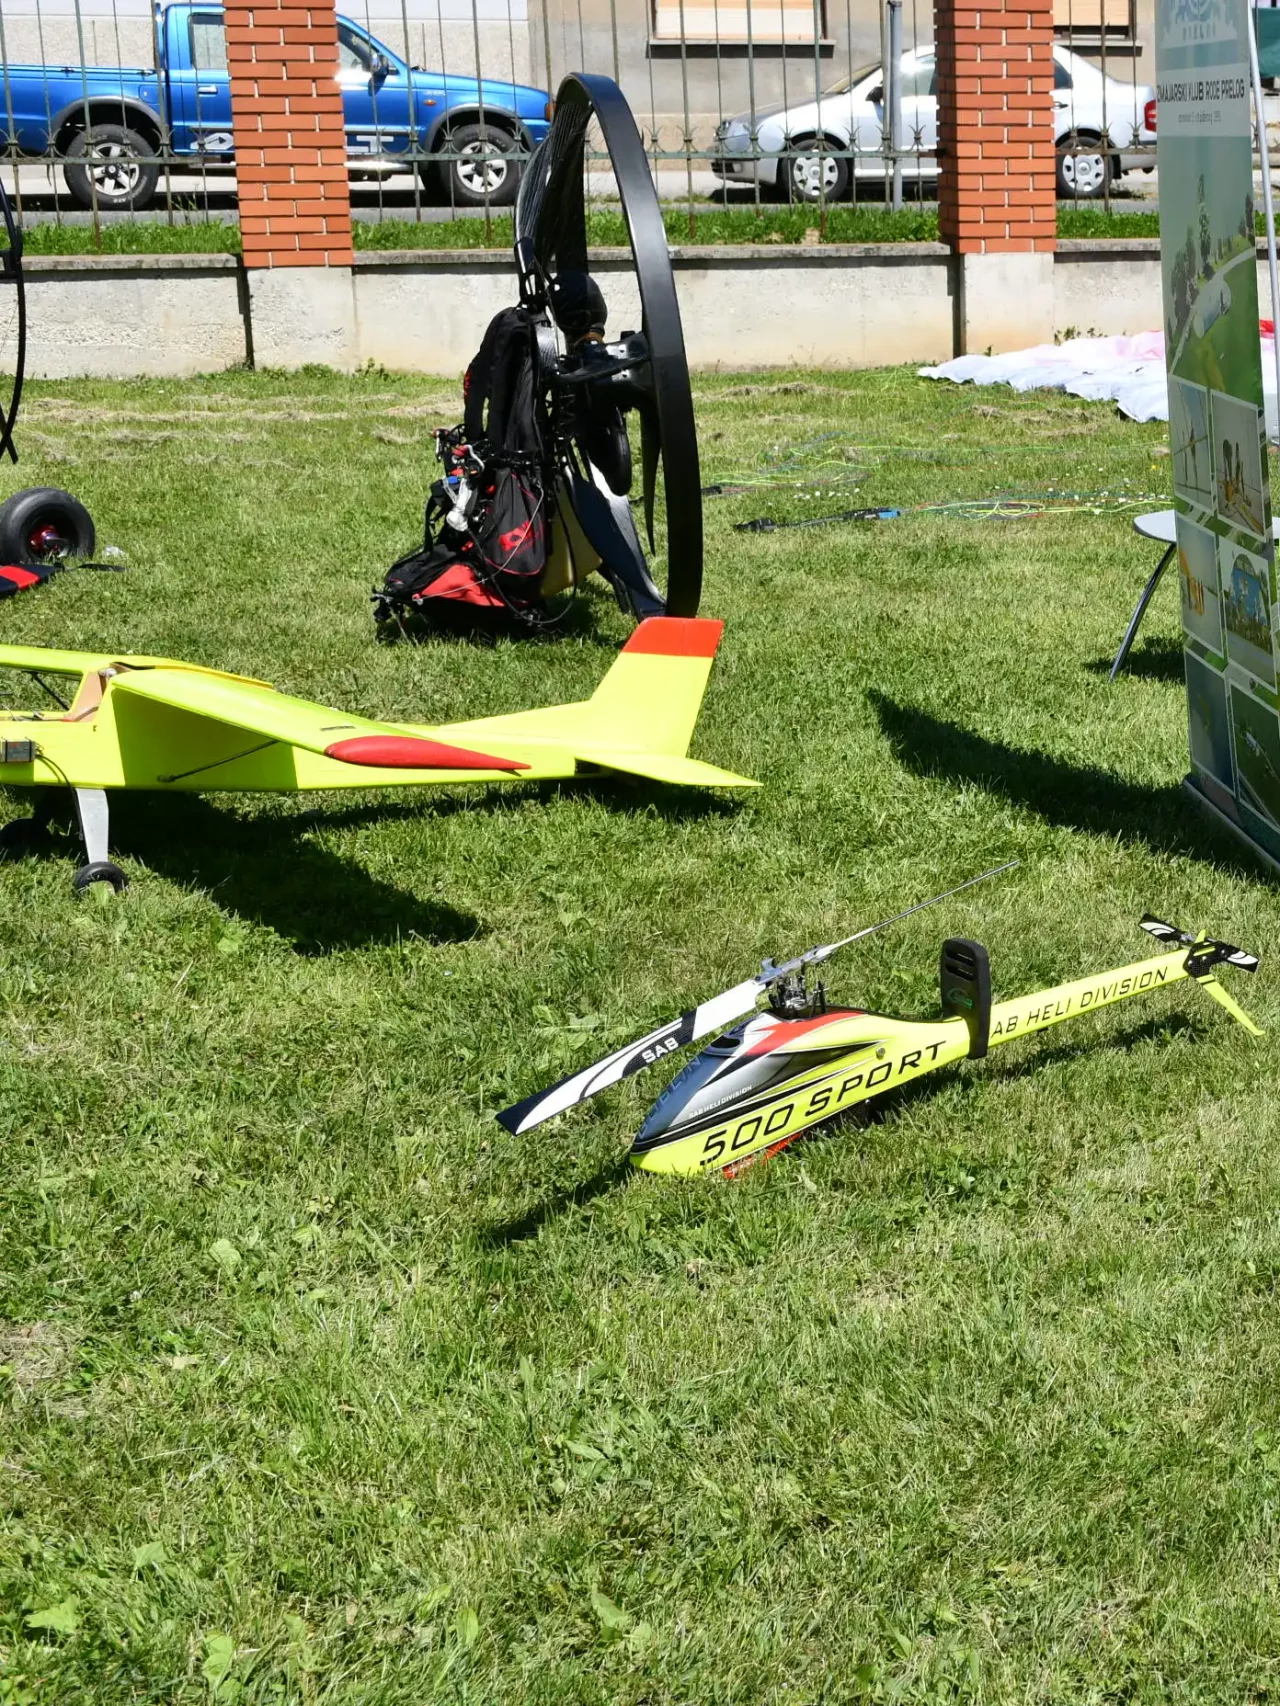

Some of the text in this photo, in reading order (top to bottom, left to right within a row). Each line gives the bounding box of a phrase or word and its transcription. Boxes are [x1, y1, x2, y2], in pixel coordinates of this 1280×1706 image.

[1221, 79, 1245, 99] PRELOG
[990, 966, 1168, 1038] AB HELI DIVISION
[641, 1037, 679, 1064] SAB
[700, 1040, 947, 1165] 500 SPORT
[721, 1084, 752, 1104] DIVISION
